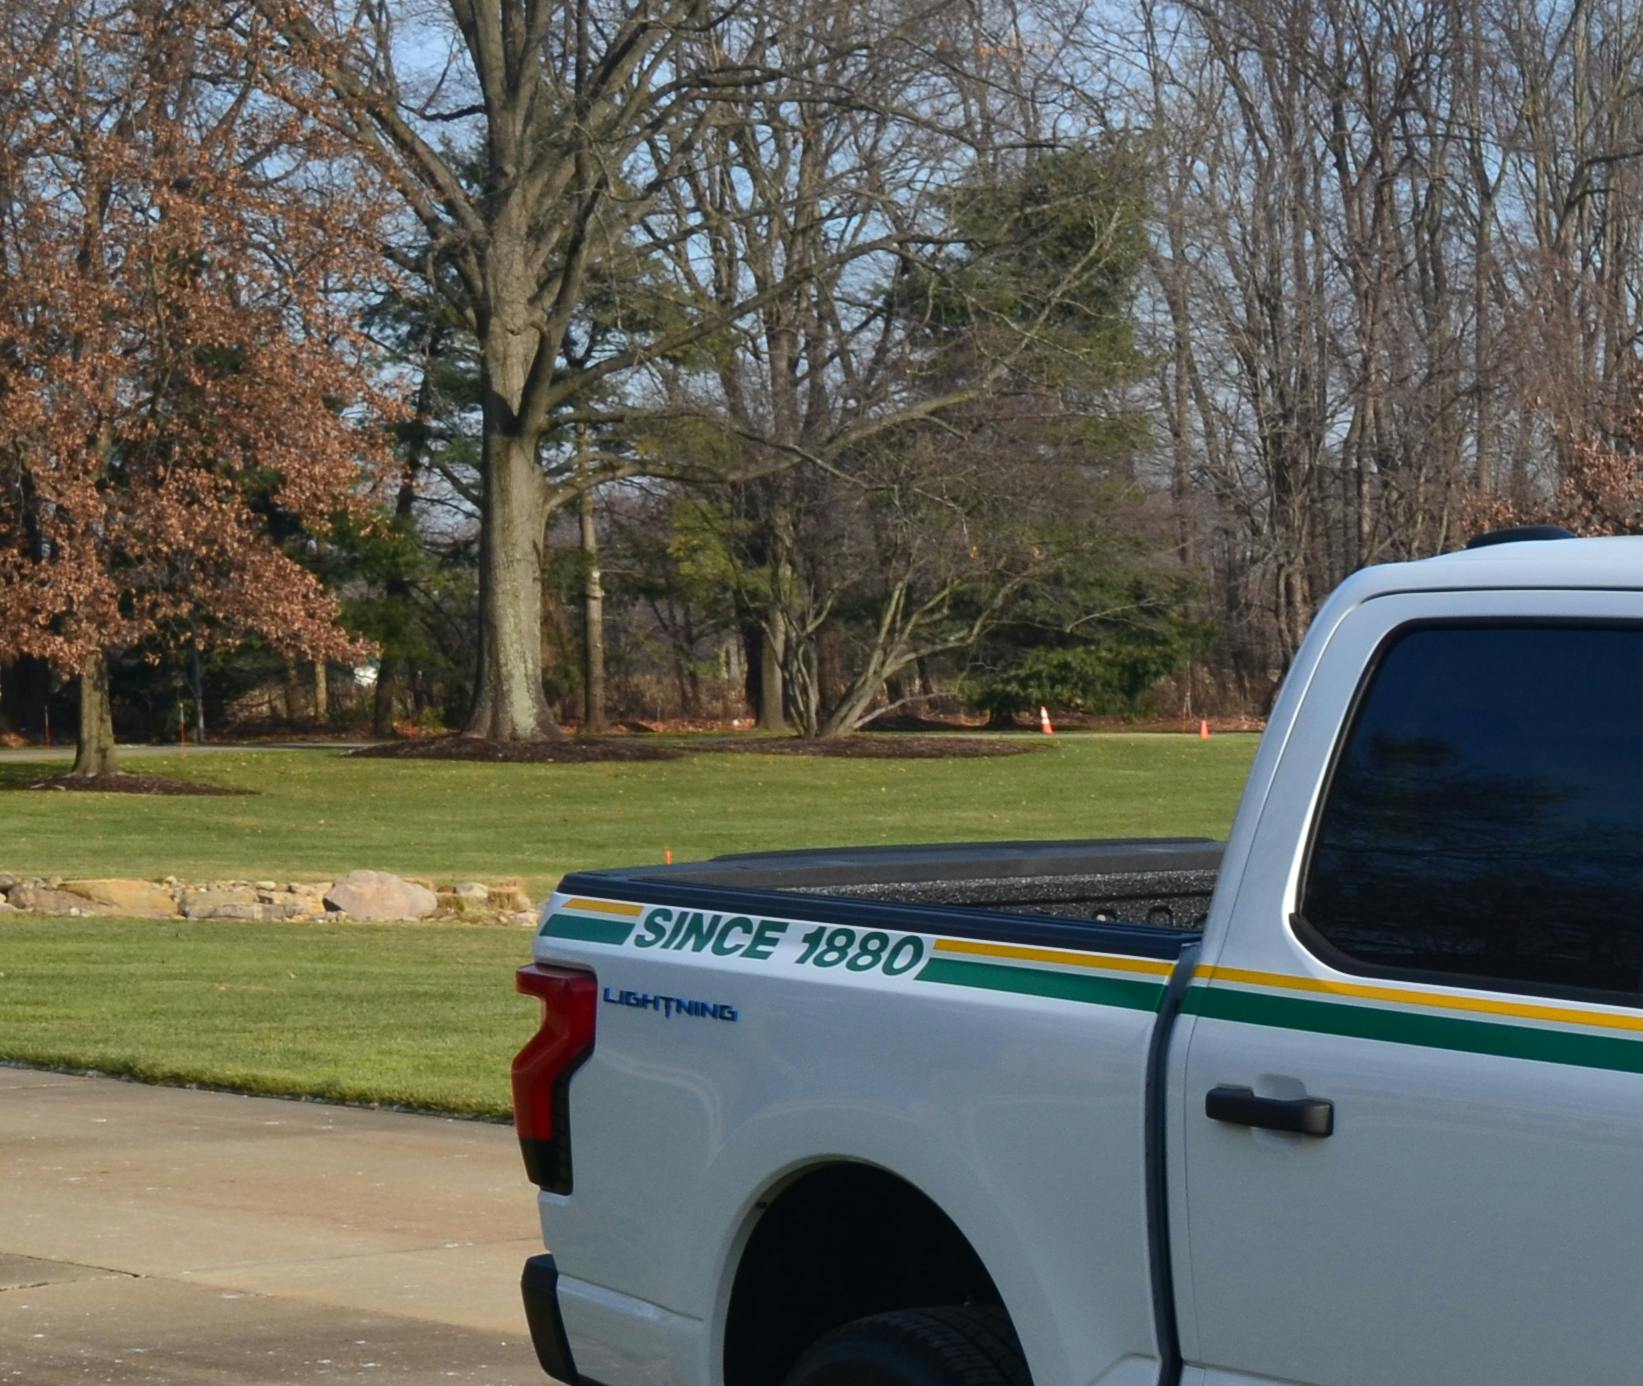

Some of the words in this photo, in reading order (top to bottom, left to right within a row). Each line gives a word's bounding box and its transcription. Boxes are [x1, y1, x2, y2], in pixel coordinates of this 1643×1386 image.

[634, 908, 789, 960] SINCE
[795, 926, 924, 976] 1880
[603, 987, 738, 1022] LIGHTNING
